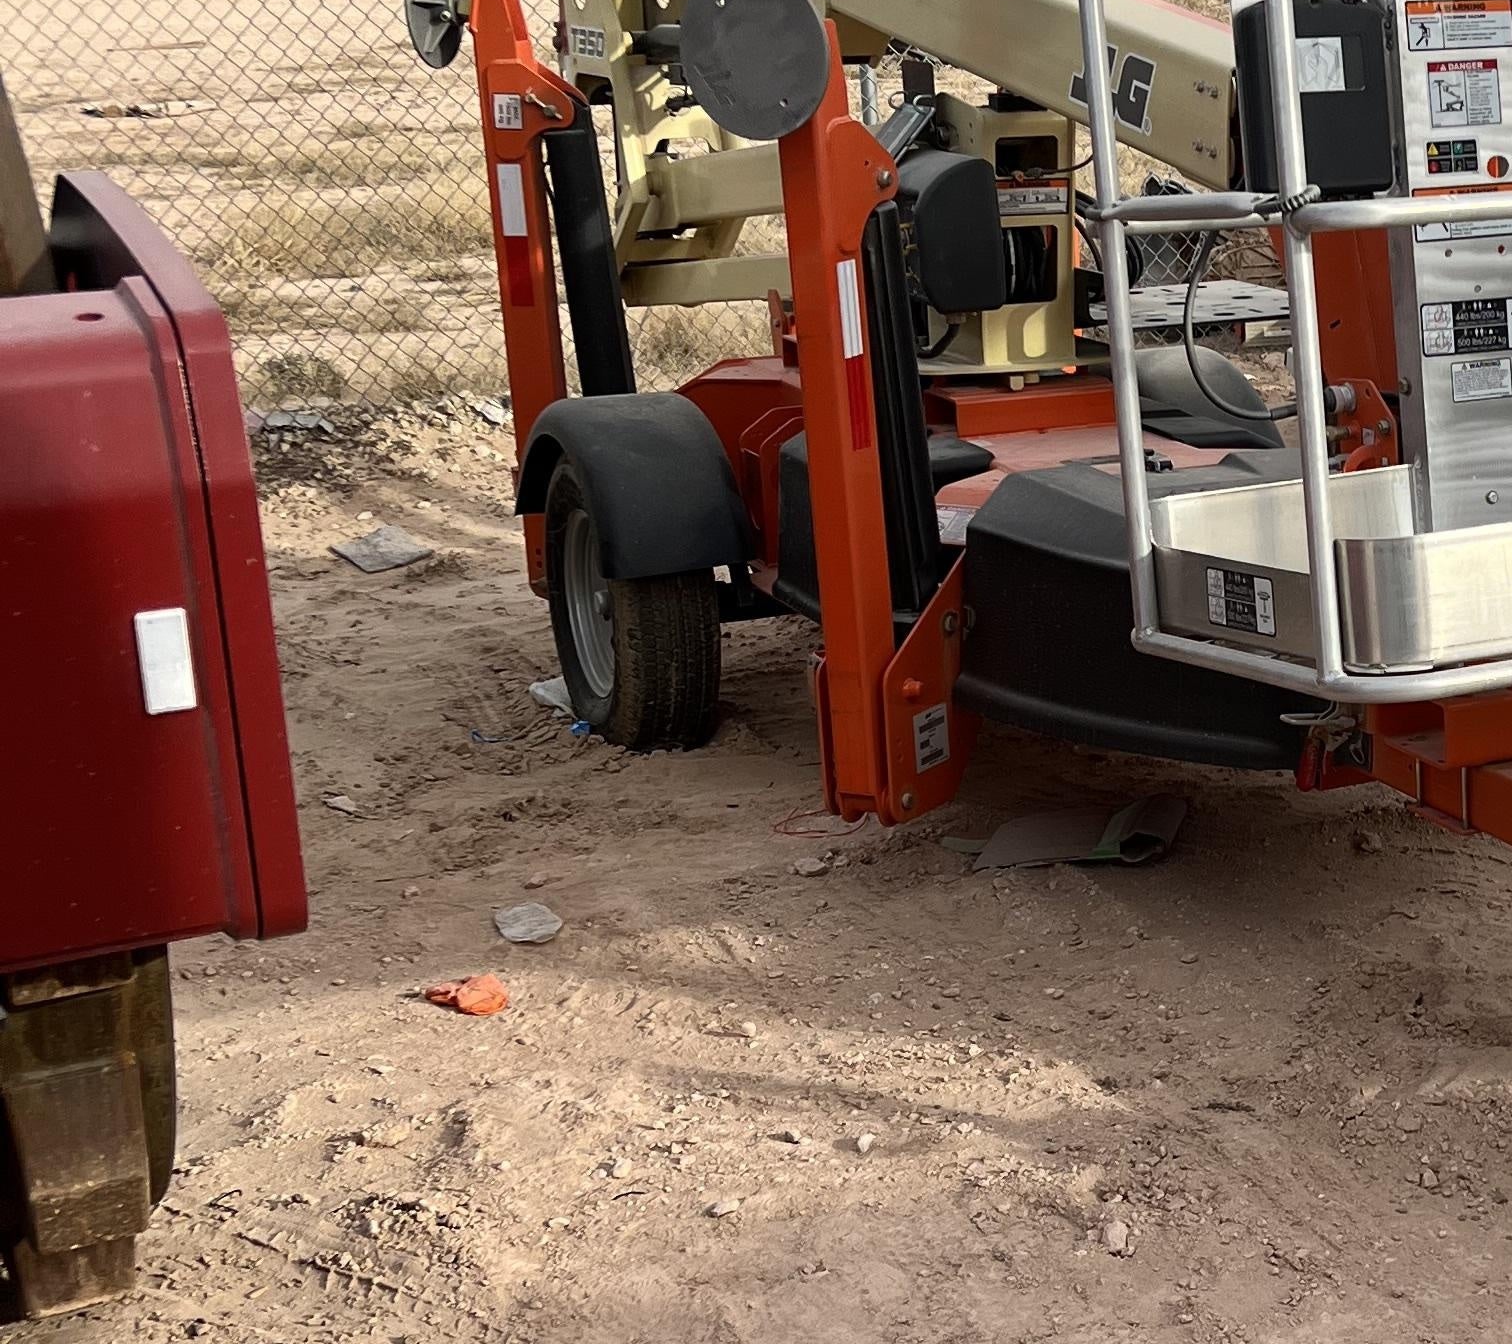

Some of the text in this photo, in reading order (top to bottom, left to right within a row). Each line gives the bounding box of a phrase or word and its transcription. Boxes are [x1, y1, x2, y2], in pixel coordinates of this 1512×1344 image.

[571, 27, 605, 58] T350
[1447, 61, 1484, 71] DANGER
[1455, 312, 1470, 321] 440
[1496, 309, 1505, 319] kg
[1498, 335, 1507, 345] kg
